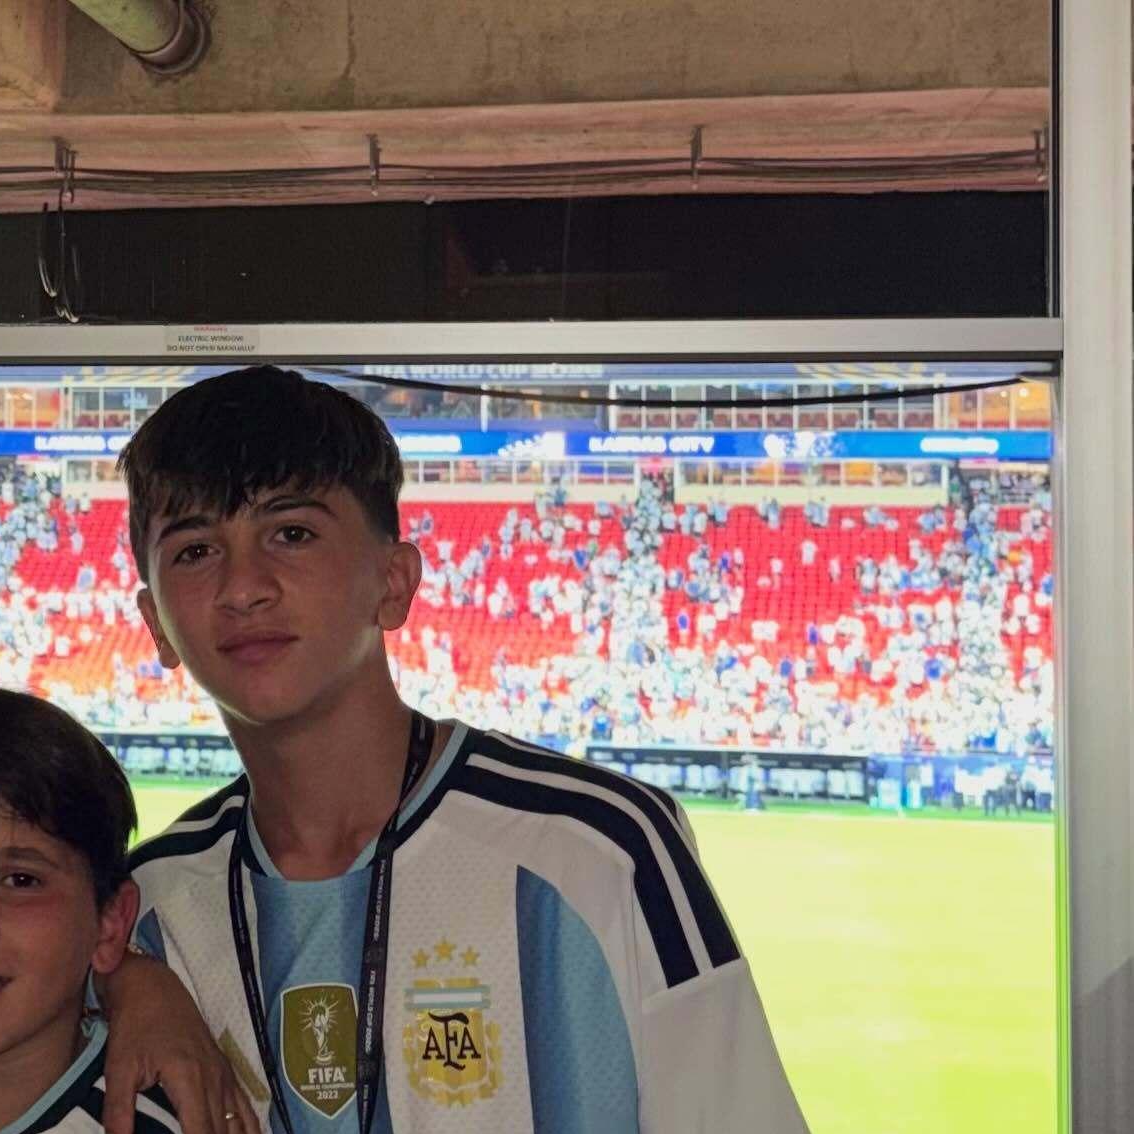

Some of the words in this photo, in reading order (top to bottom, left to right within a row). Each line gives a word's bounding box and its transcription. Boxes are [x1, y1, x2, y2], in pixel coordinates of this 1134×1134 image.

[177, 335, 210, 343] ELECTRIC
[211, 335, 244, 343] WINDOW
[421, 1012, 481, 1071] AFA
[308, 1068, 345, 1084] FIFA
[316, 1090, 339, 1100] 2022
